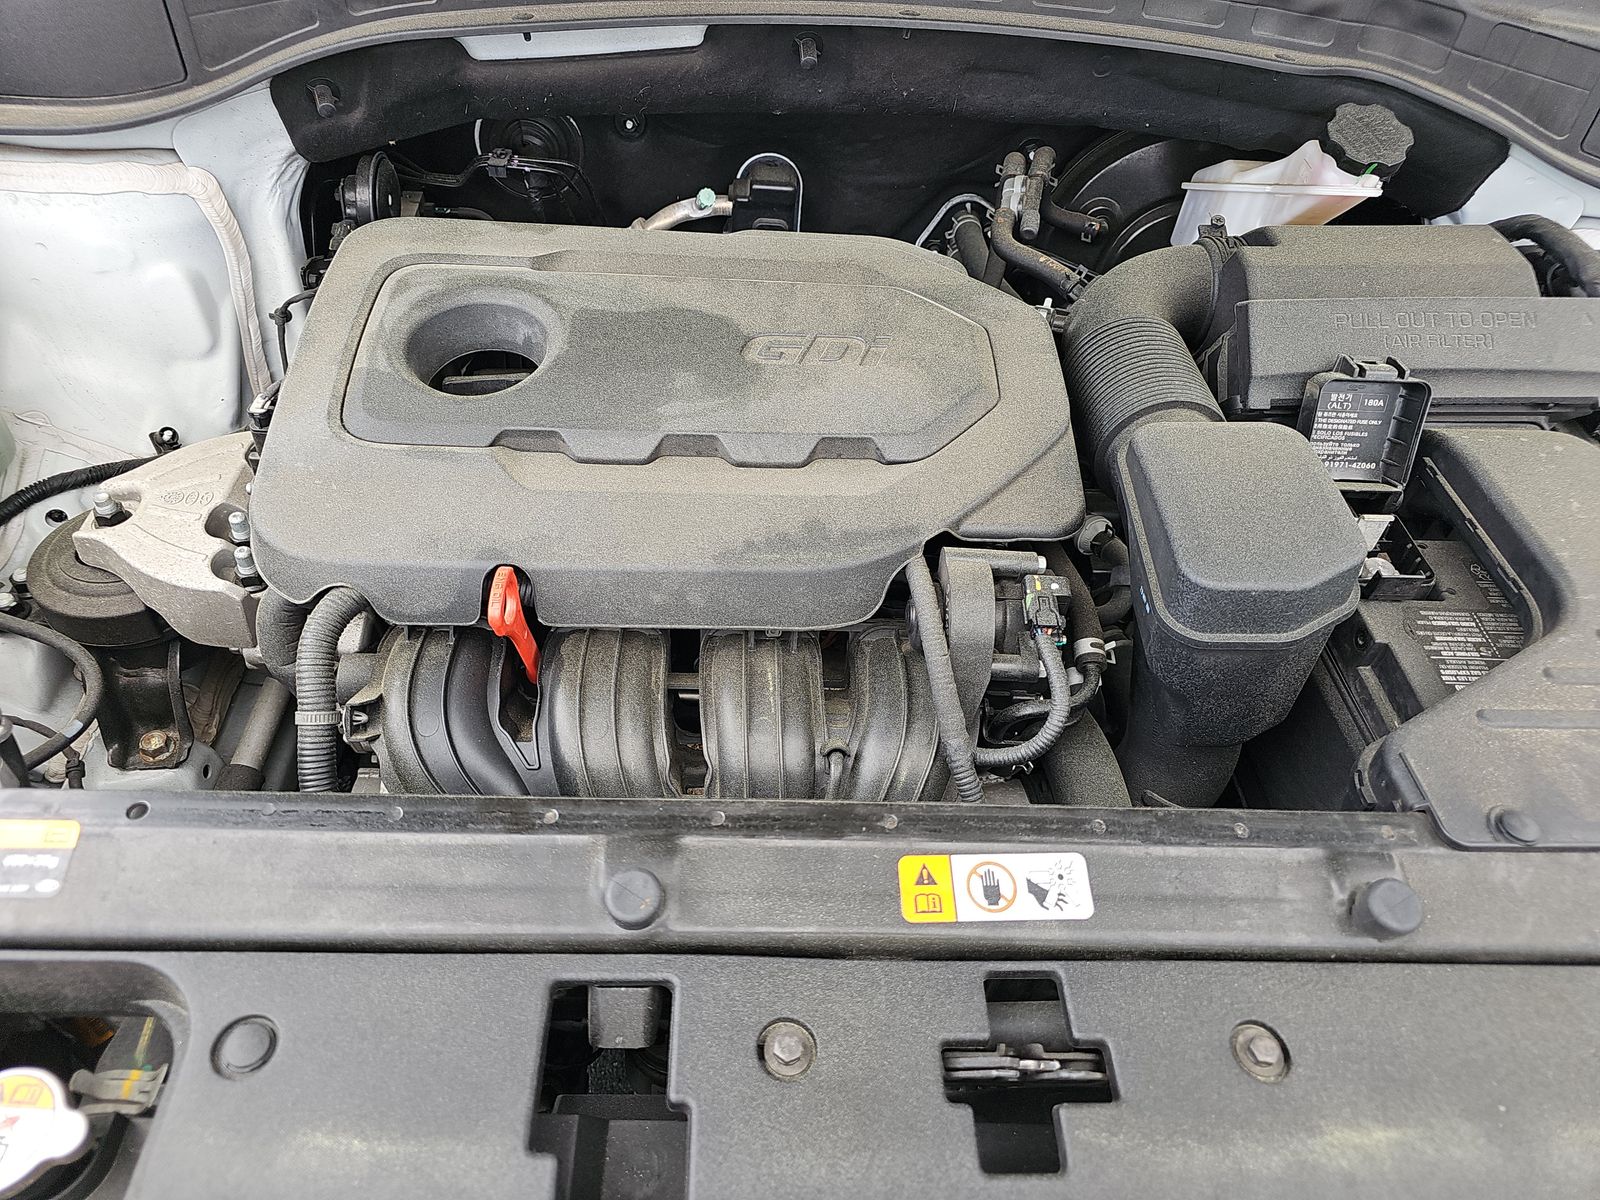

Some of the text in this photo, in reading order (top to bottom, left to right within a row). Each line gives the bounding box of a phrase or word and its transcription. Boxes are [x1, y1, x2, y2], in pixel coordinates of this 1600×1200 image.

[1334, 311, 1537, 329] PULL OUT TO OPEN
[740, 332, 893, 366] GDi
[1330, 393, 1353, 402] 발전기
[1327, 402, 1352, 410] (ALT)
[1363, 398, 1384, 407] 180A
[1324, 461, 1376, 469] 91971-4Z060
